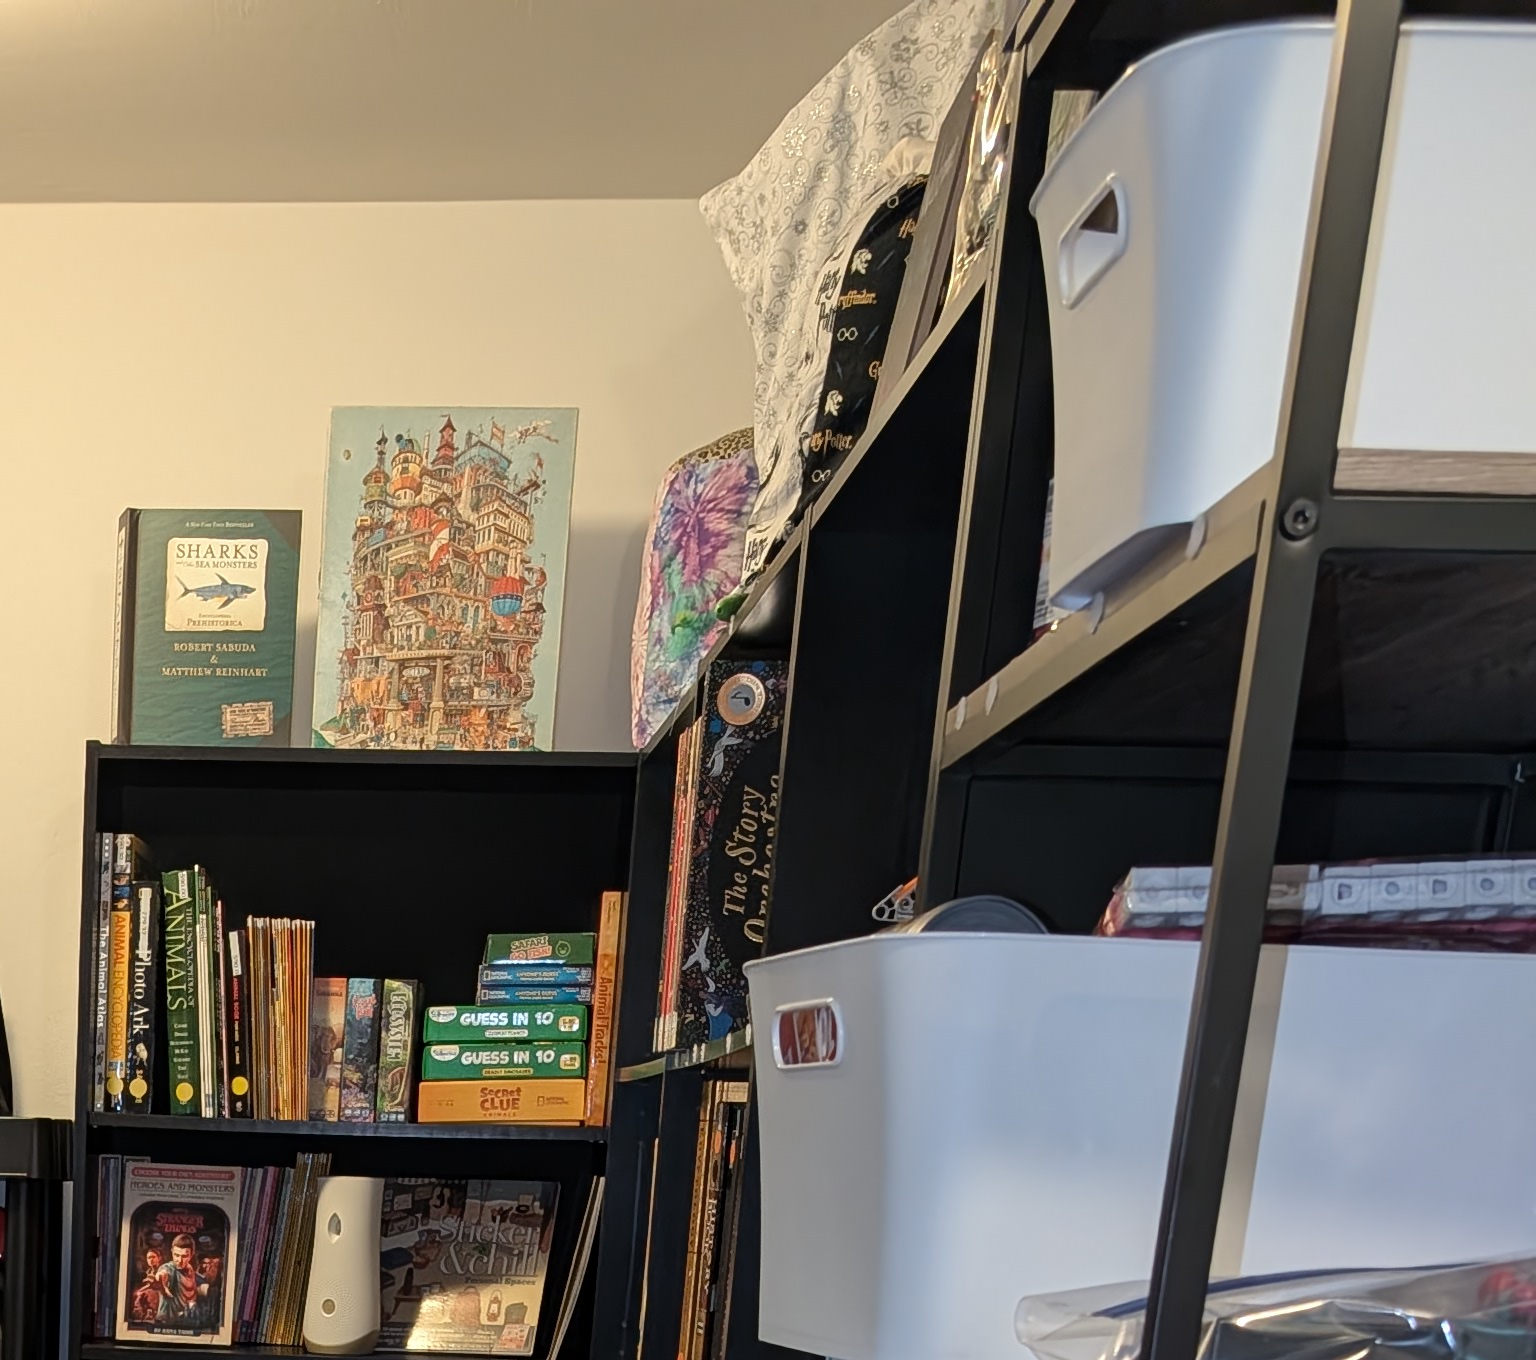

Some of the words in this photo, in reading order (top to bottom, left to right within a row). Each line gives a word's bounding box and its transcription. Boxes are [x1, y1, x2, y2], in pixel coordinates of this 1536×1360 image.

[176, 544, 258, 559] SHARKS
[174, 643, 213, 652] ROBERT
[216, 643, 256, 652] SABUDA
[210, 655, 218, 663] &
[162, 667, 213, 676] MATTHEW
[216, 668, 268, 677] REINHART
[724, 783, 766, 868] Story
[723, 871, 748, 917] The
[114, 915, 126, 966] ANIMAL
[510, 936, 548, 951] SAFARI
[163, 888, 194, 1012] ANIMALS
[599, 976, 612, 1020] Animal
[112, 967, 125, 1060] ENCYCLOPEDIA
[460, 1012, 508, 1026] GUESS
[512, 1013, 529, 1025] IN
[535, 1012, 554, 1025] 10
[388, 992, 408, 1061] ECOSYSTEM
[596, 1022, 608, 1064] Tracks!
[461, 1051, 510, 1065] GUESS
[514, 1051, 530, 1064] IN
[536, 1050, 555, 1063] 10
[480, 1086, 522, 1099] Secret
[480, 1097, 520, 1111] CLUE
[130, 1181, 164, 1190] HEROES
[167, 1182, 186, 1190] AND
[188, 1184, 235, 1192] MONSTERS
[156, 1213, 204, 1227] STRANGER
[440, 1214, 541, 1245] Sticker
